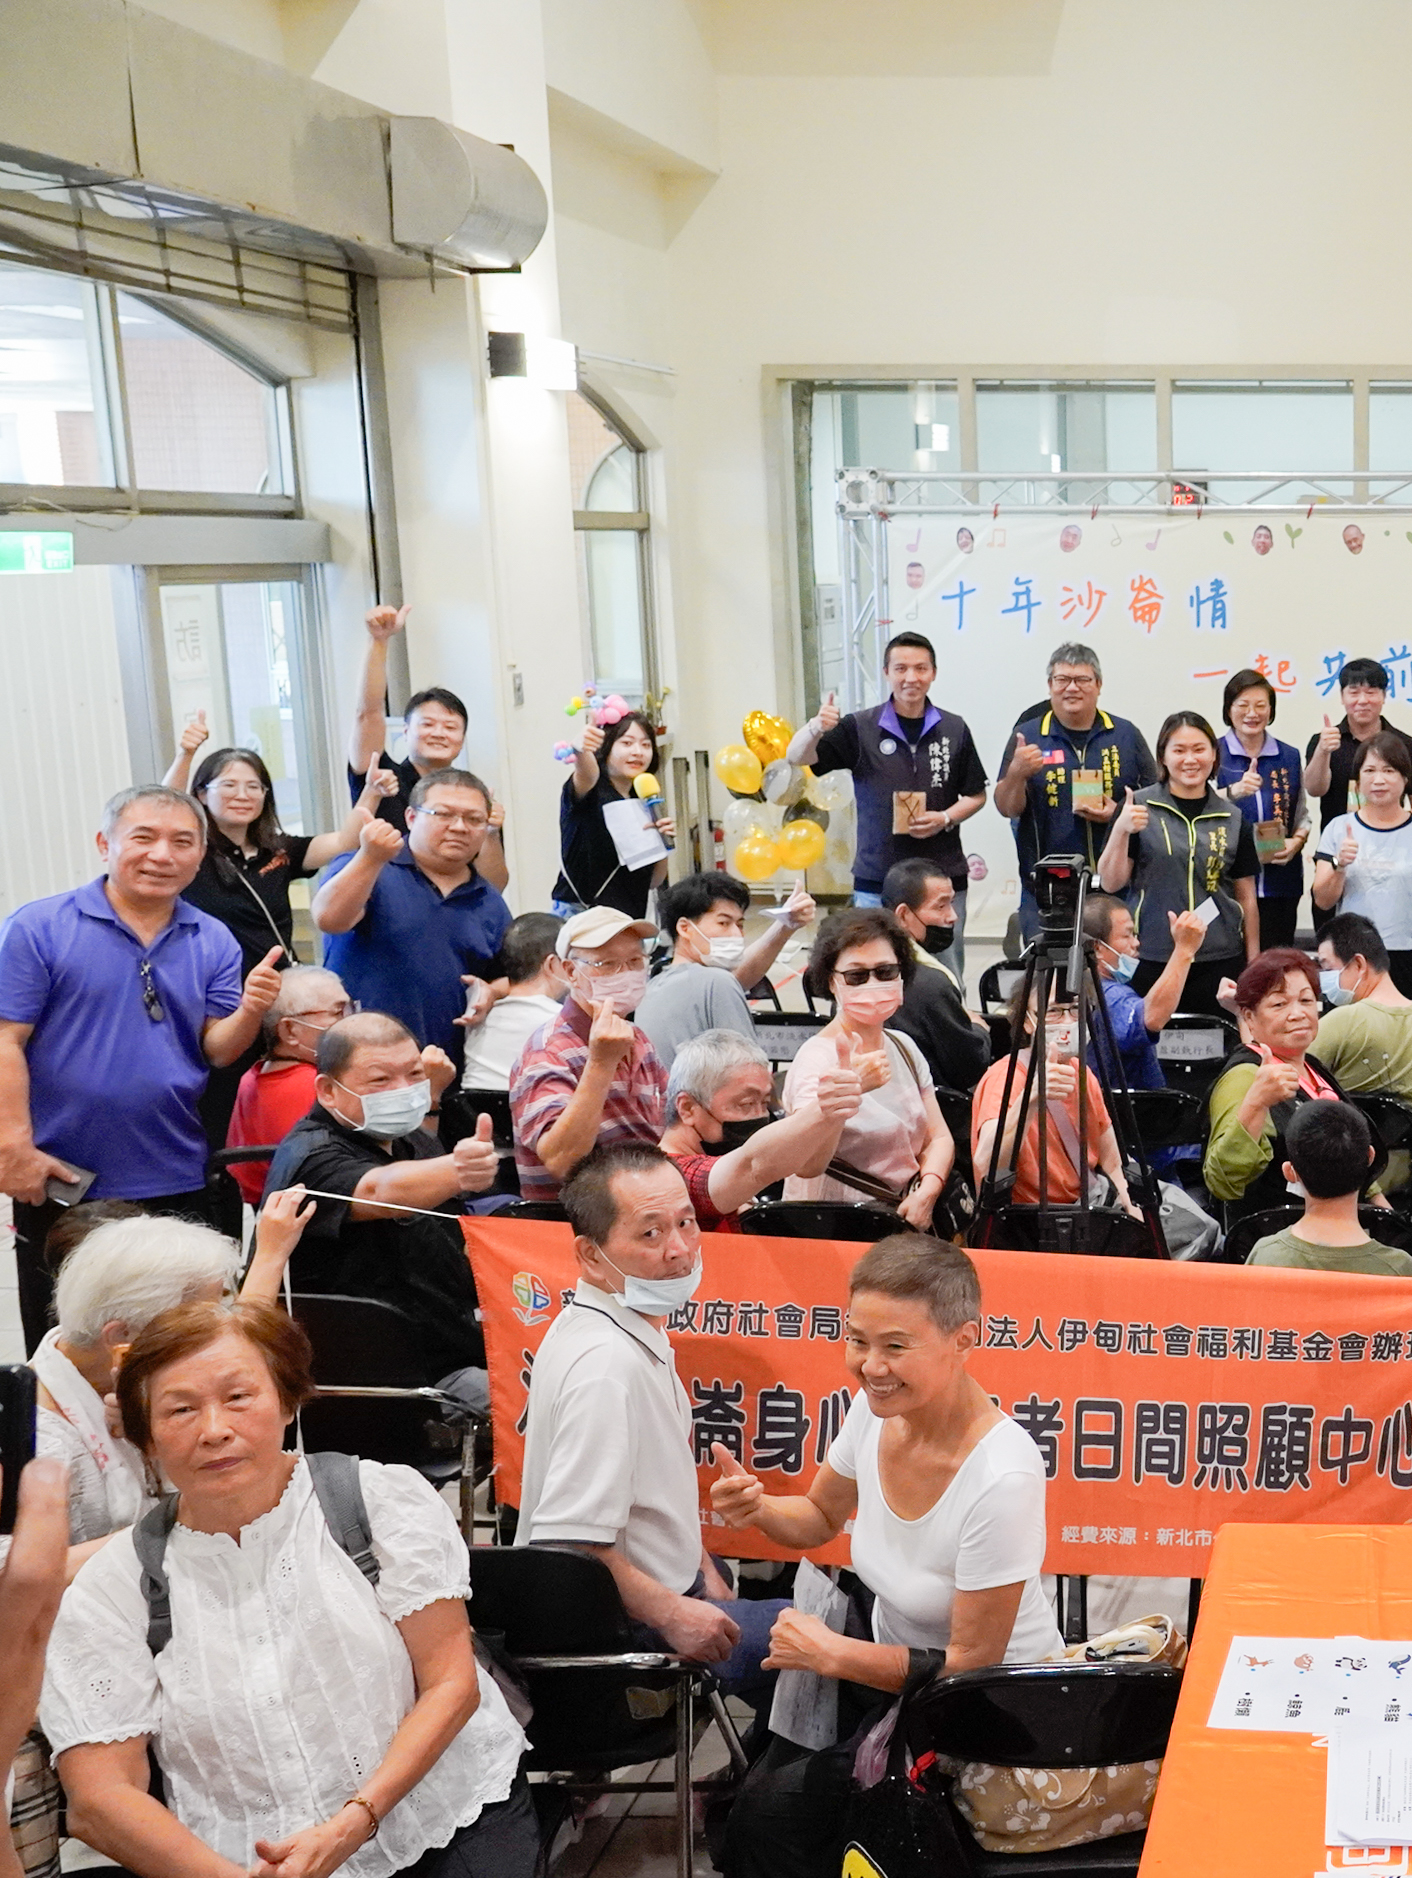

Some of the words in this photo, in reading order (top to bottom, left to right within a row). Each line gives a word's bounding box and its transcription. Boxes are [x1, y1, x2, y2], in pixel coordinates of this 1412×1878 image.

[942, 574, 1227, 633] 十年沙崙情
[666, 1299, 843, 1343] 政府社會局
